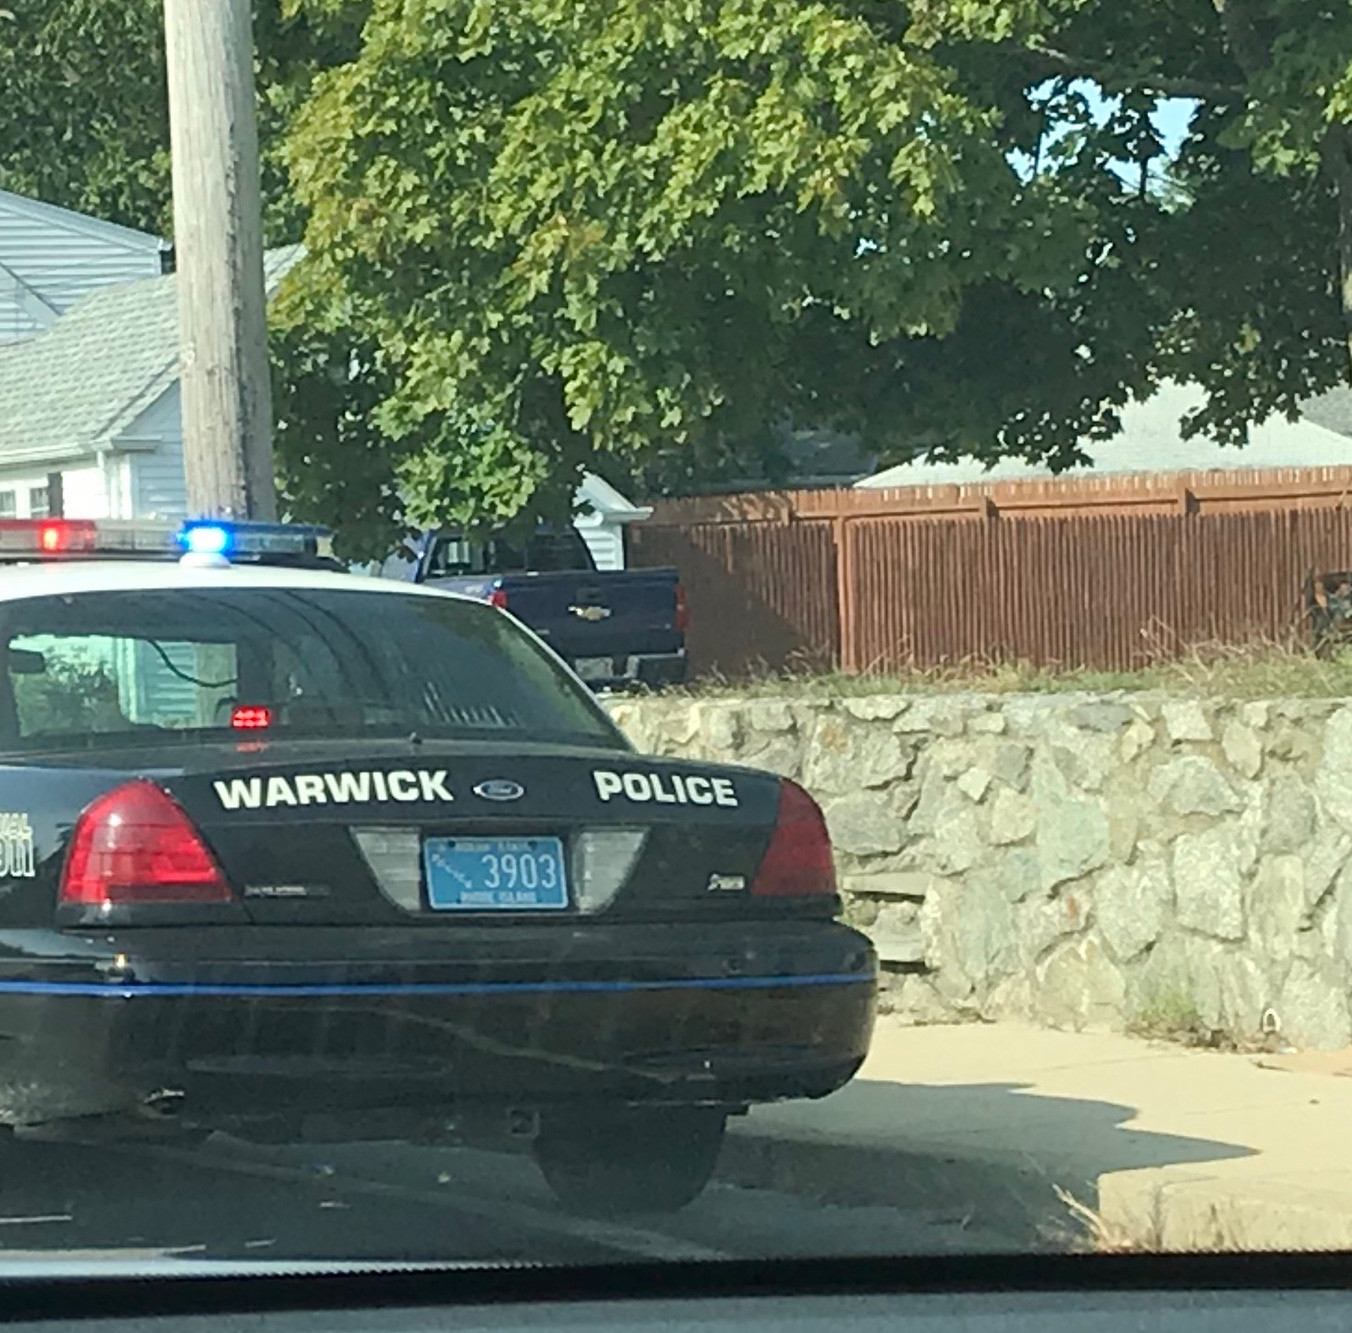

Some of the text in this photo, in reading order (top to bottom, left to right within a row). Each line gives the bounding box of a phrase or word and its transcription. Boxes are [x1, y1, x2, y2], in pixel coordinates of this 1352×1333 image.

[212, 769, 739, 810] WARWICK POLICE
[480, 853, 557, 889] 3903
